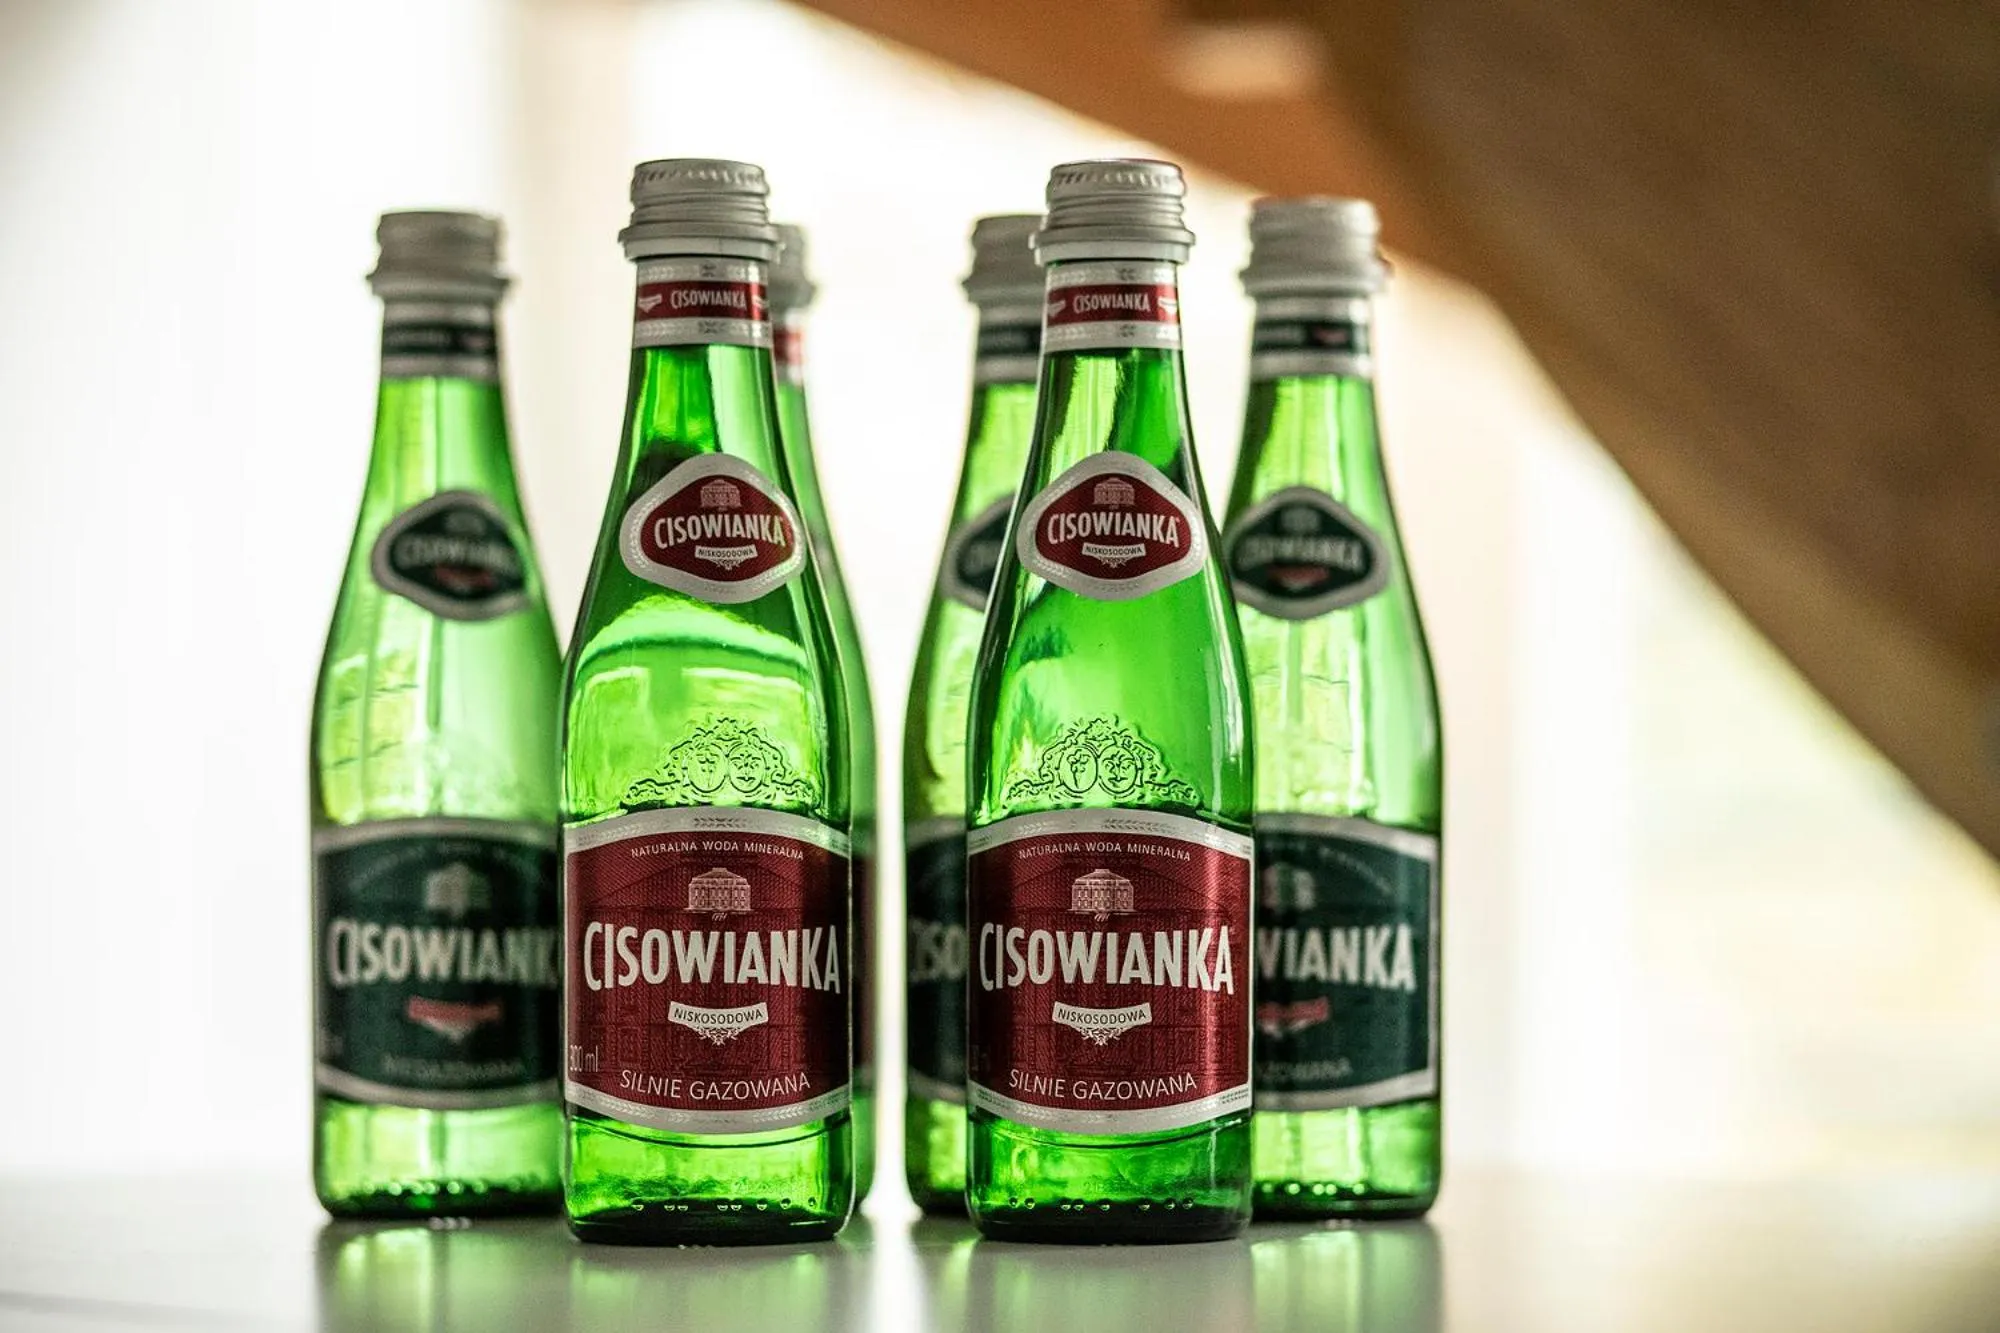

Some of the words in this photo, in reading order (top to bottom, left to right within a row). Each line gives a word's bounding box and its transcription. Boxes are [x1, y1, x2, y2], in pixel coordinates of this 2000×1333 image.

[671, 290, 747, 311] CISOWIANKA
[1073, 292, 1151, 314] CISOWIANKA
[654, 513, 786, 549] CISOWIANKA
[1047, 511, 1179, 549] CISOWIANKA
[697, 547, 754, 558] NISKOSODOWA
[1085, 545, 1142, 556] NISKOSODOWA
[631, 841, 698, 858] NATURALNA
[702, 840, 739, 851] WODA
[744, 842, 804, 860] MINERALNA
[1019, 842, 1081, 860] NATURALNA
[1085, 841, 1122, 853] WODA
[1127, 843, 1191, 861] MINERALNA
[326, 917, 558, 988] CISOWIANK
[583, 921, 841, 994] CISOWIANKA
[979, 921, 1234, 995] CISOWIANKA
[673, 1006, 763, 1024] NISKOSODOWA
[1057, 1006, 1147, 1024] NISKOSODOWA
[620, 1069, 682, 1099] SILNIE
[689, 1071, 811, 1101] GAZOWANA
[1009, 1069, 1066, 1098] SILNIE
[1072, 1071, 1198, 1101] GAZOWANA
